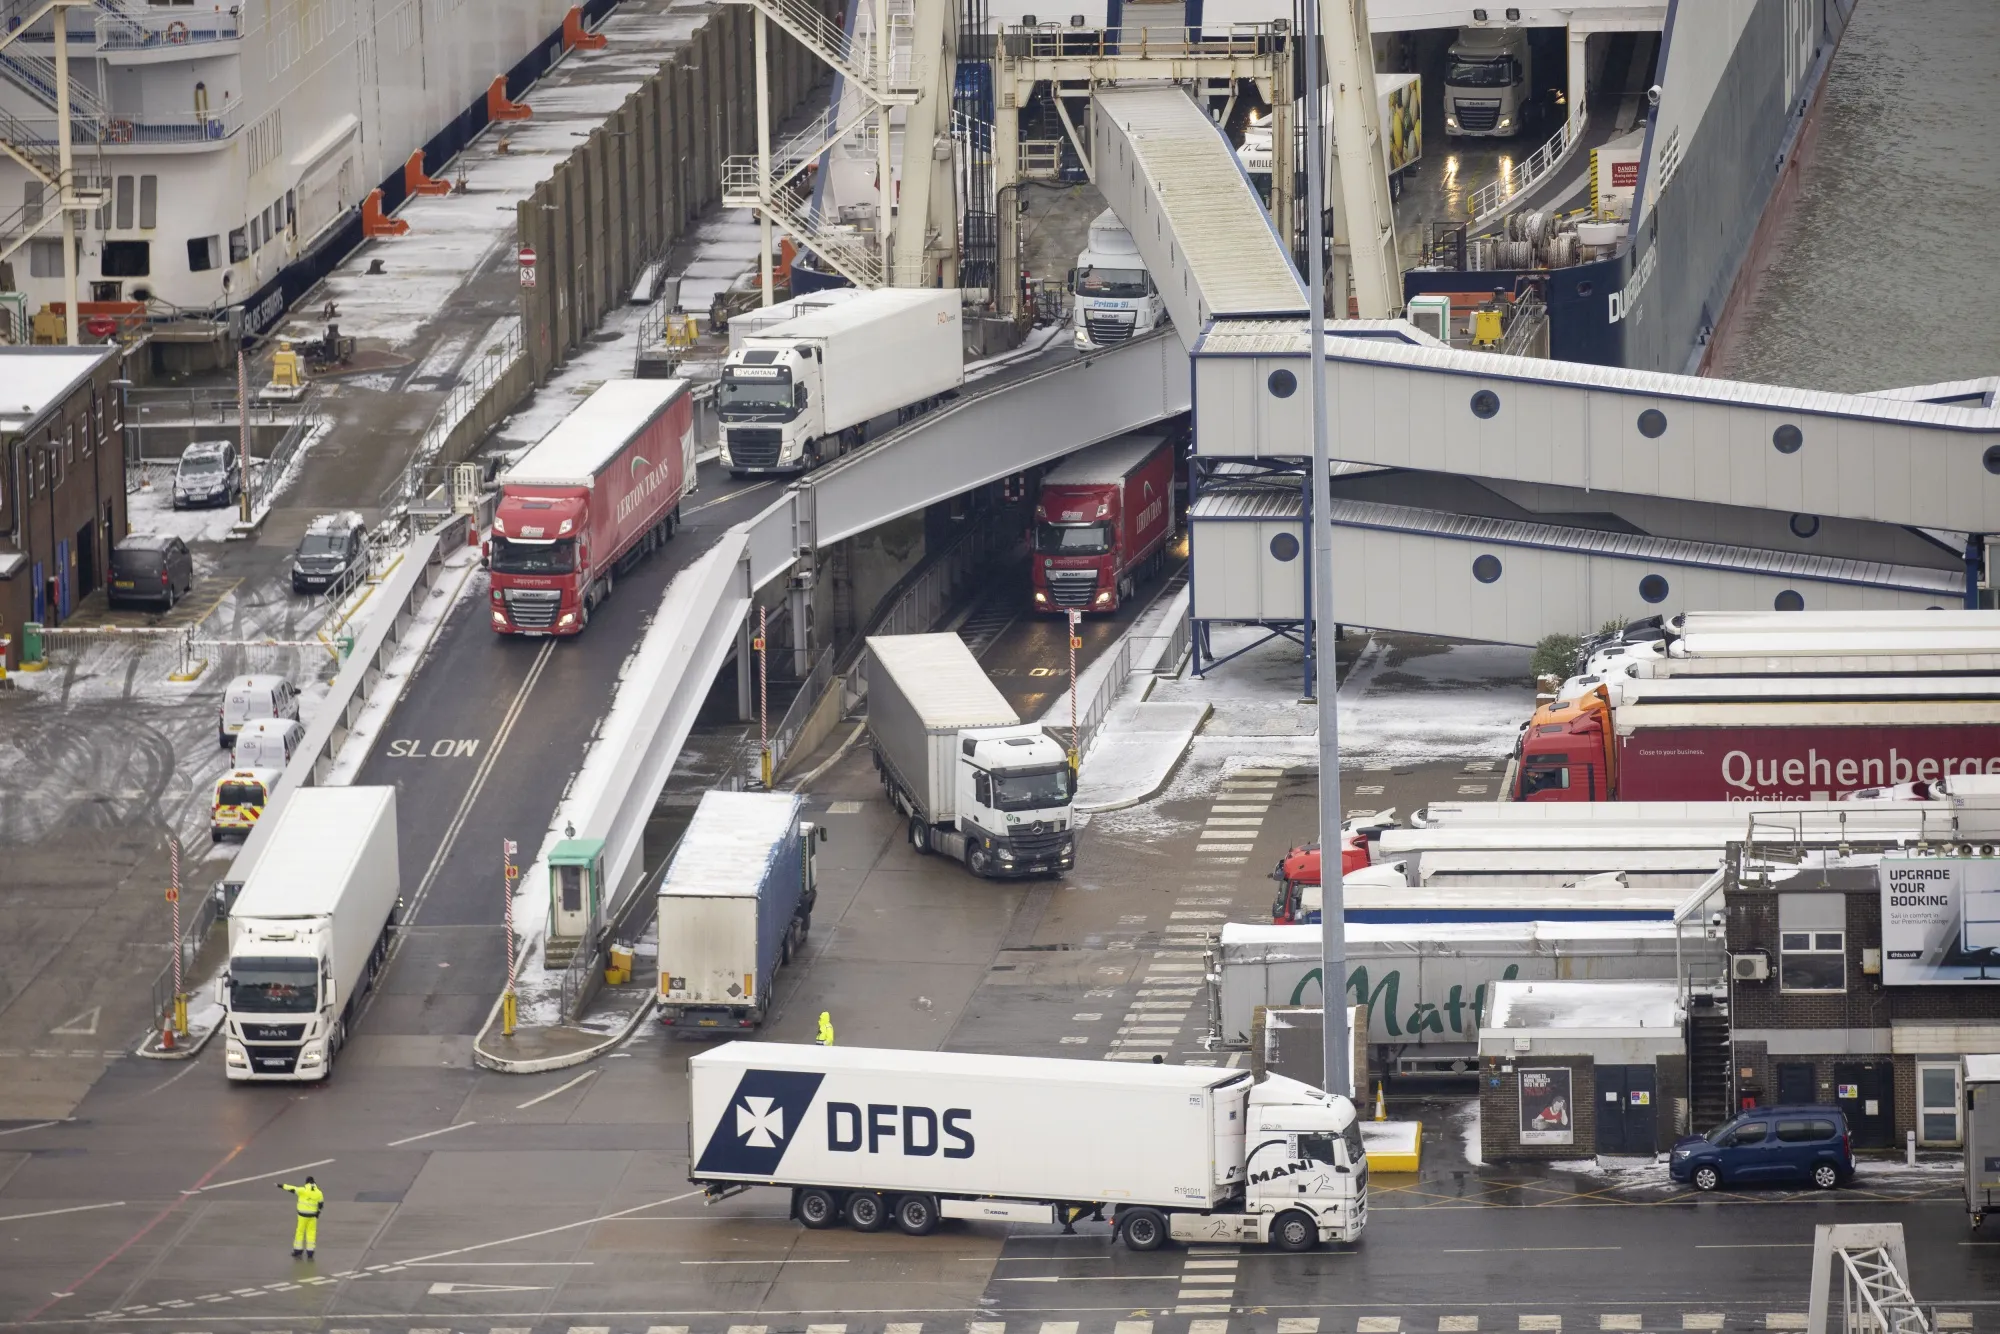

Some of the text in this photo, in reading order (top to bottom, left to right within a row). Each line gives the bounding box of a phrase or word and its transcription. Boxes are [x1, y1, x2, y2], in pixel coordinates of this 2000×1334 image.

[616, 457, 669, 526] LERTON TRANS
[386, 739, 480, 757] SLOW
[1889, 869, 1951, 880] UPGRADE
[1890, 882, 1925, 893] YOUR
[1890, 895, 1948, 906] BOOKING
[259, 1029, 288, 1037] MAN
[826, 1101, 975, 1159] DFDS
